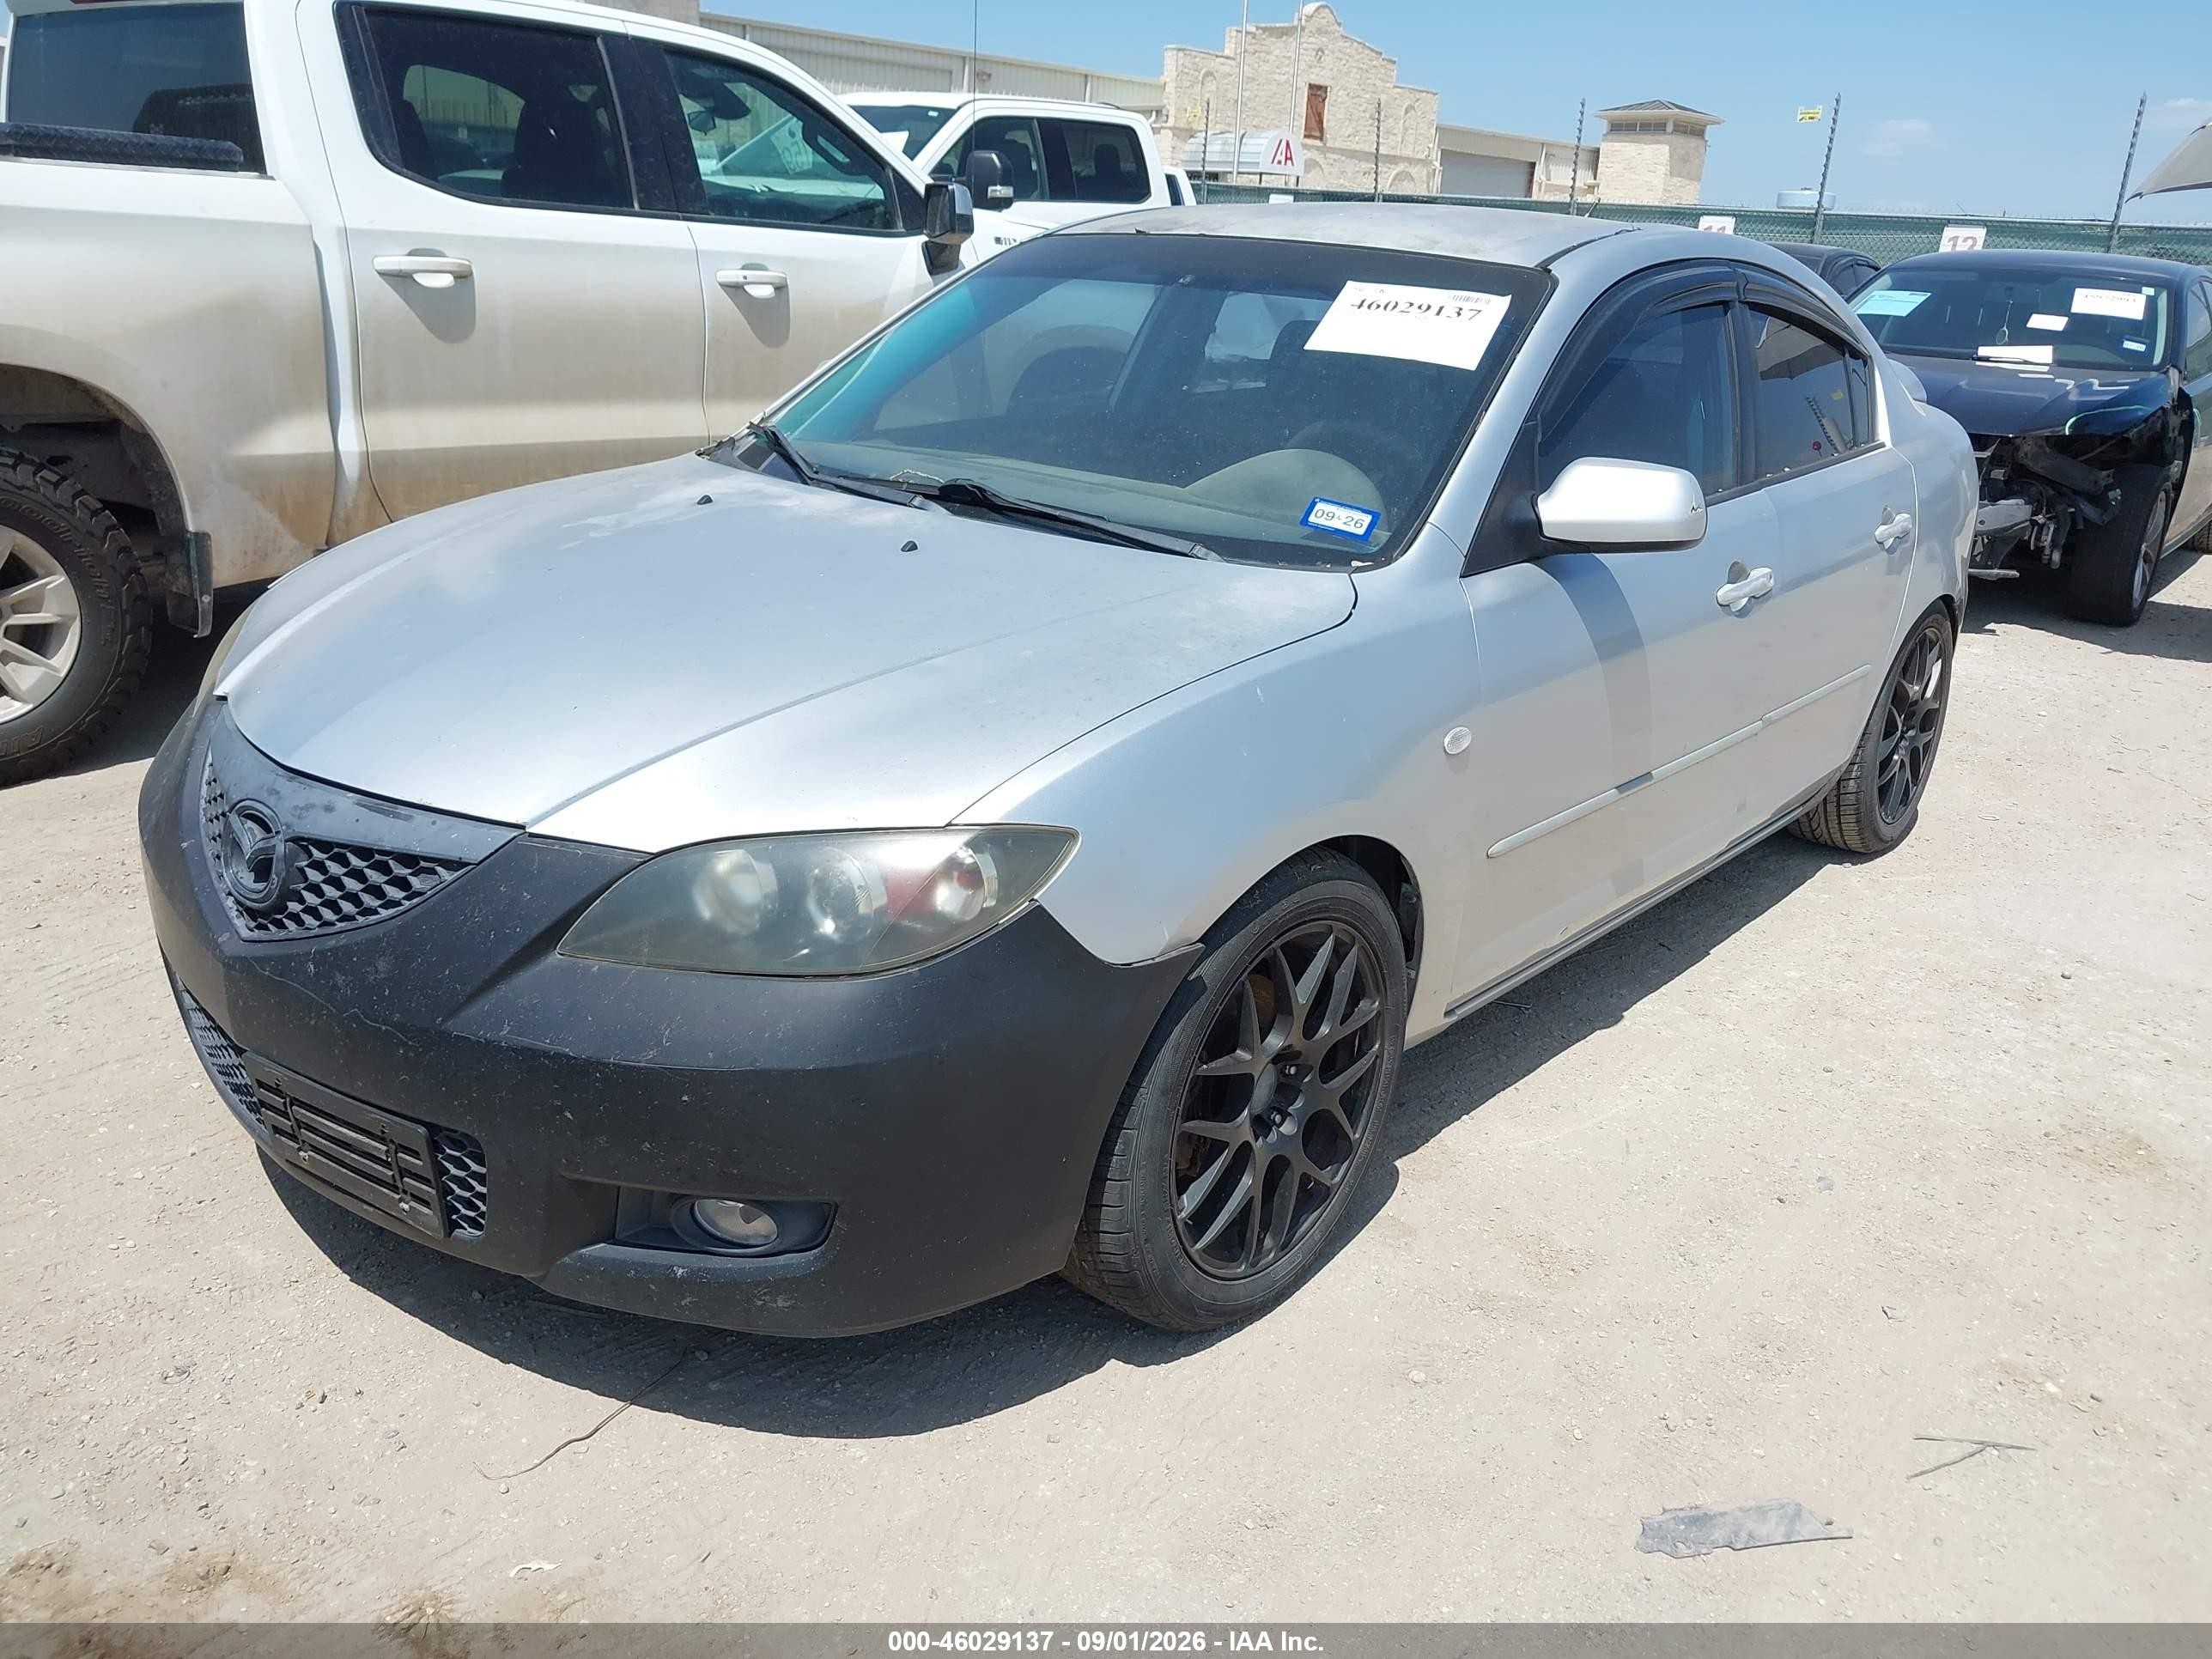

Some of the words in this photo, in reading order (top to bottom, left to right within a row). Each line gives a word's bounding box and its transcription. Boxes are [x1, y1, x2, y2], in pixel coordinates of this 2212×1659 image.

[1350, 297, 1483, 321] 46029137
[1314, 508, 1335, 521] 09
[1342, 515, 1365, 529] 26
